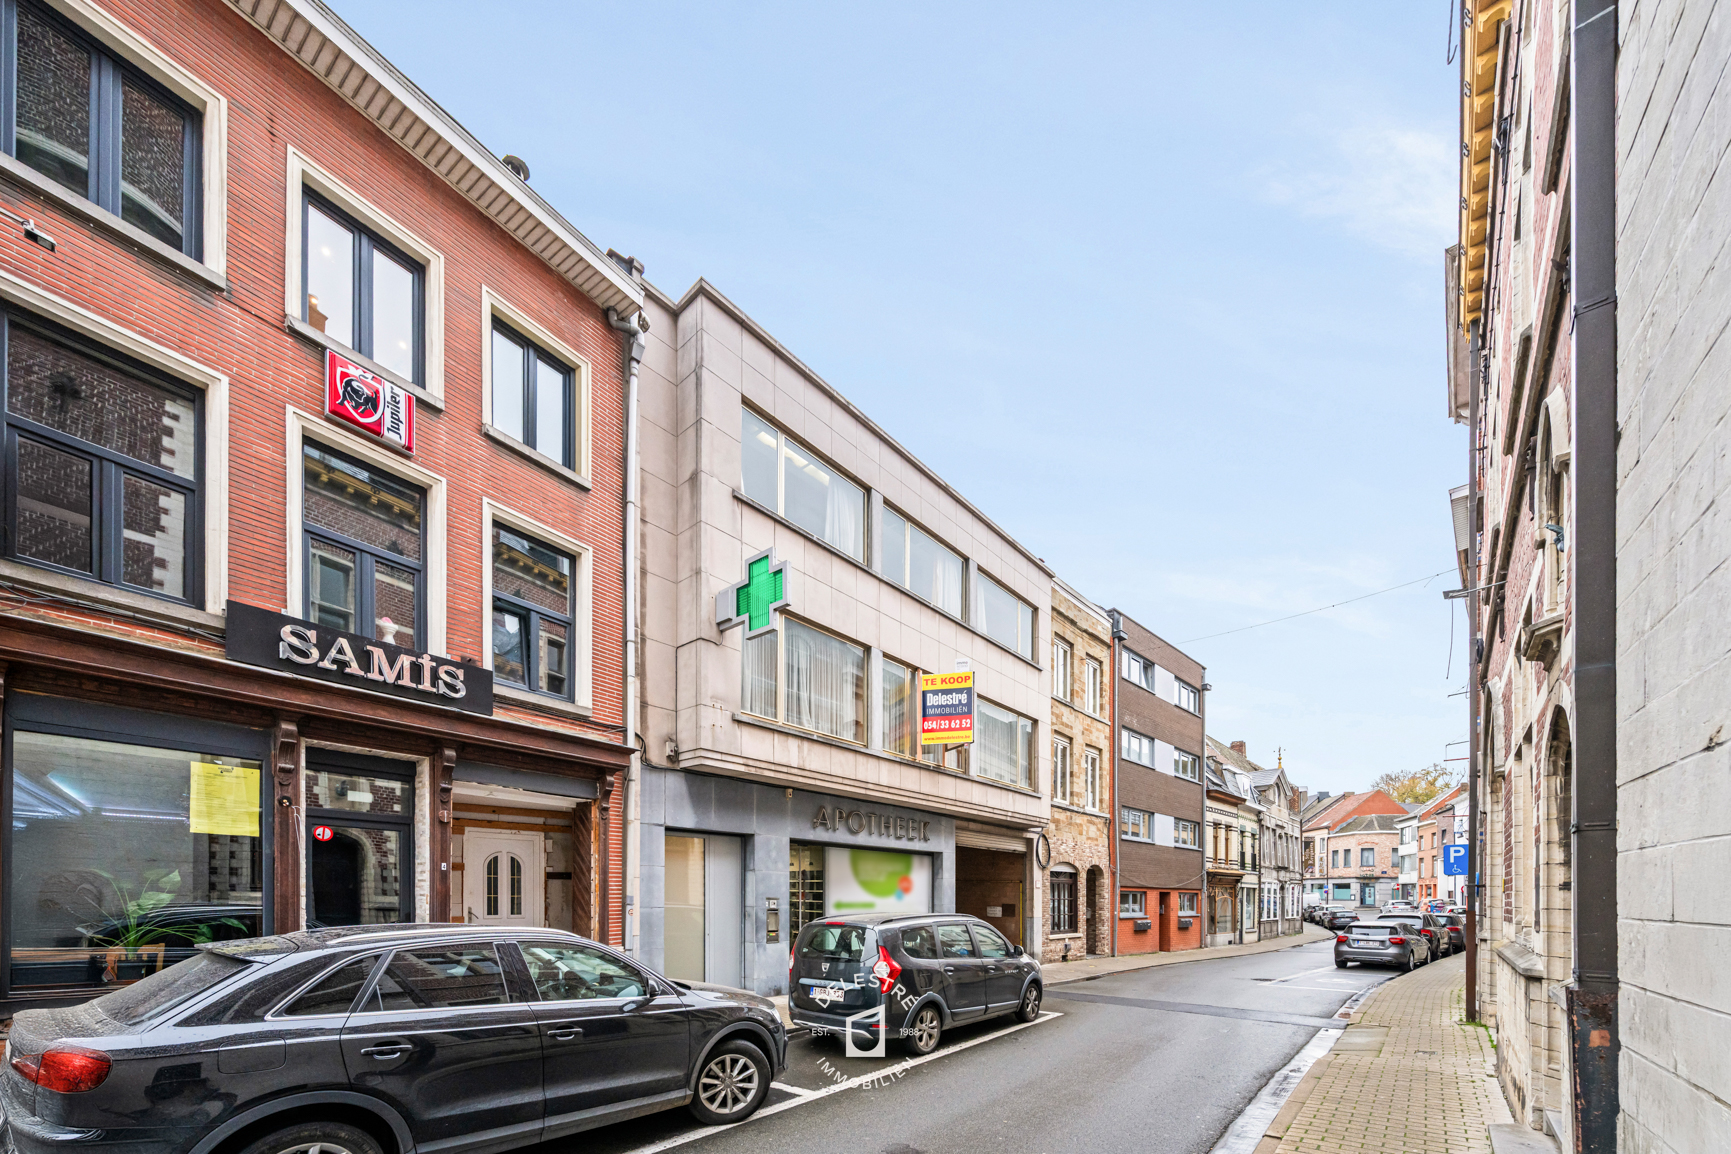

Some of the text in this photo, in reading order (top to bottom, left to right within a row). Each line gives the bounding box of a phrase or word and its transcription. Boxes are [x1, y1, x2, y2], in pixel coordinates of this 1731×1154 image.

[386, 385, 404, 441] Jupiler
[940, 676, 970, 684] KOOP
[926, 690, 967, 706] Delestré
[926, 706, 967, 714] IMMOBILIËN
[923, 718, 971, 730] 054/33 62 52
[813, 805, 930, 842] APOTHEEK
[1450, 847, 1465, 863] P
